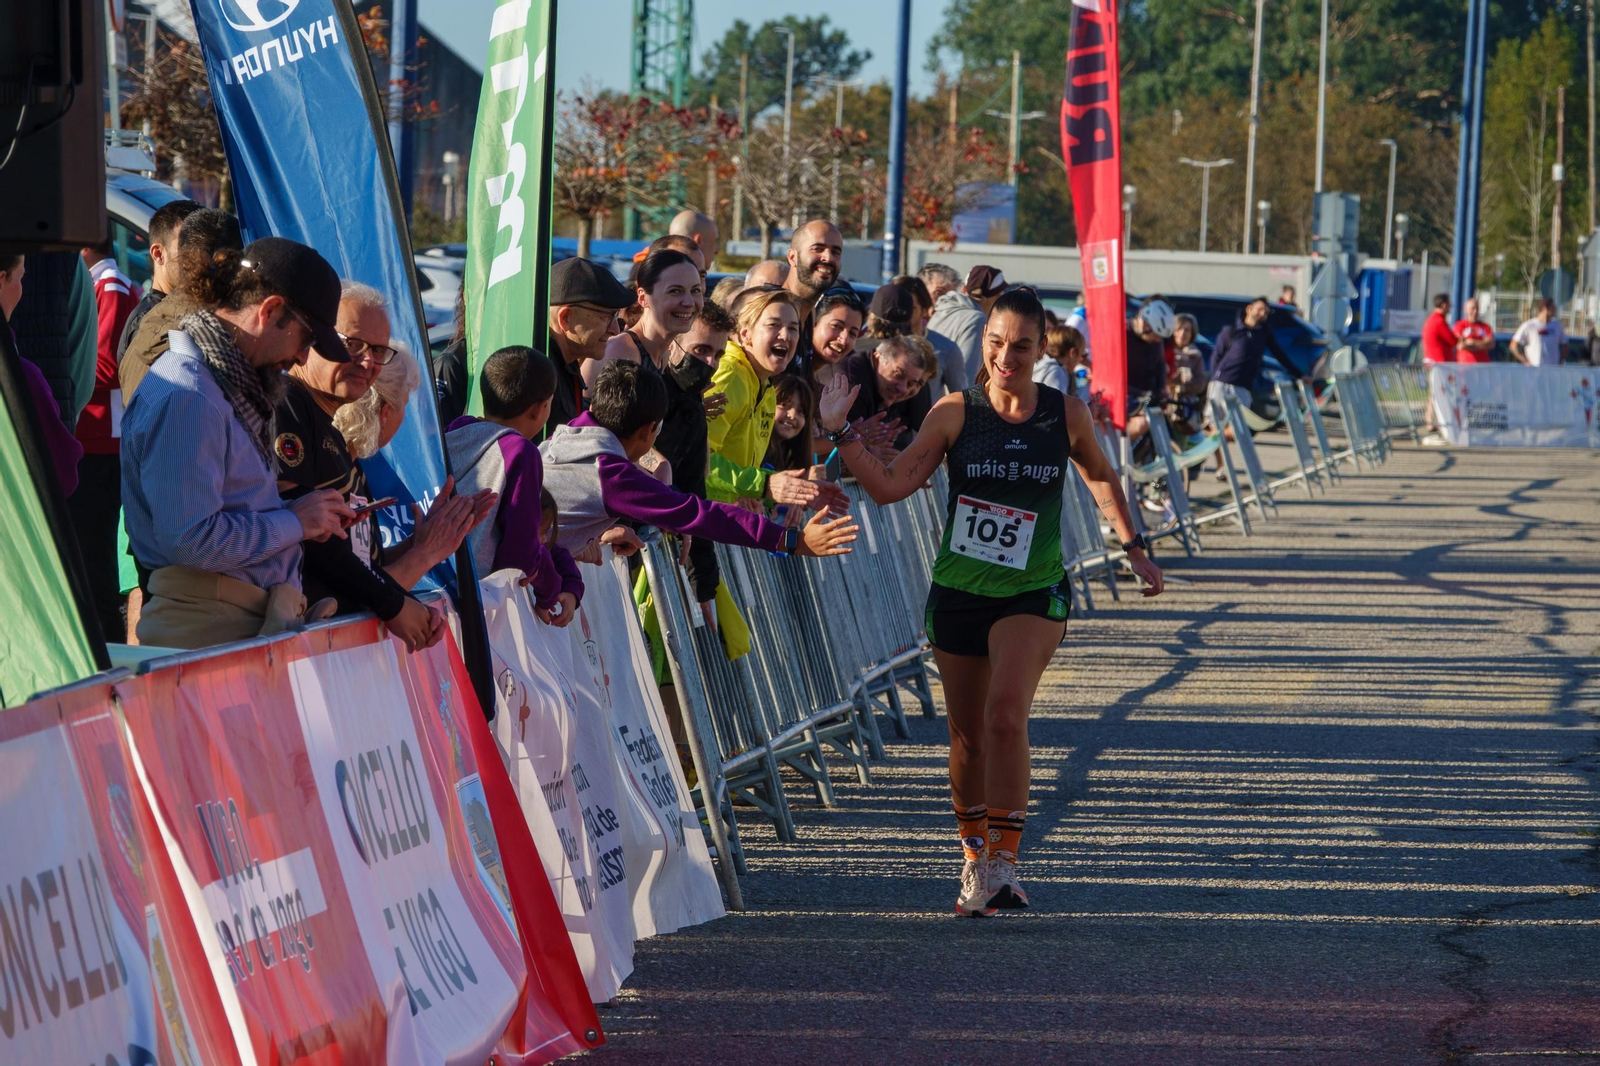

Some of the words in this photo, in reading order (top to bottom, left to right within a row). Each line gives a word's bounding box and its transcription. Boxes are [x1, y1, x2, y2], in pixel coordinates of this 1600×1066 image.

[1004, 443, 1028, 451] amura
[967, 459, 1006, 478] máis
[1022, 464, 1060, 484] auga
[965, 515, 1019, 548] 105
[396, 887, 478, 1000] VIGO
